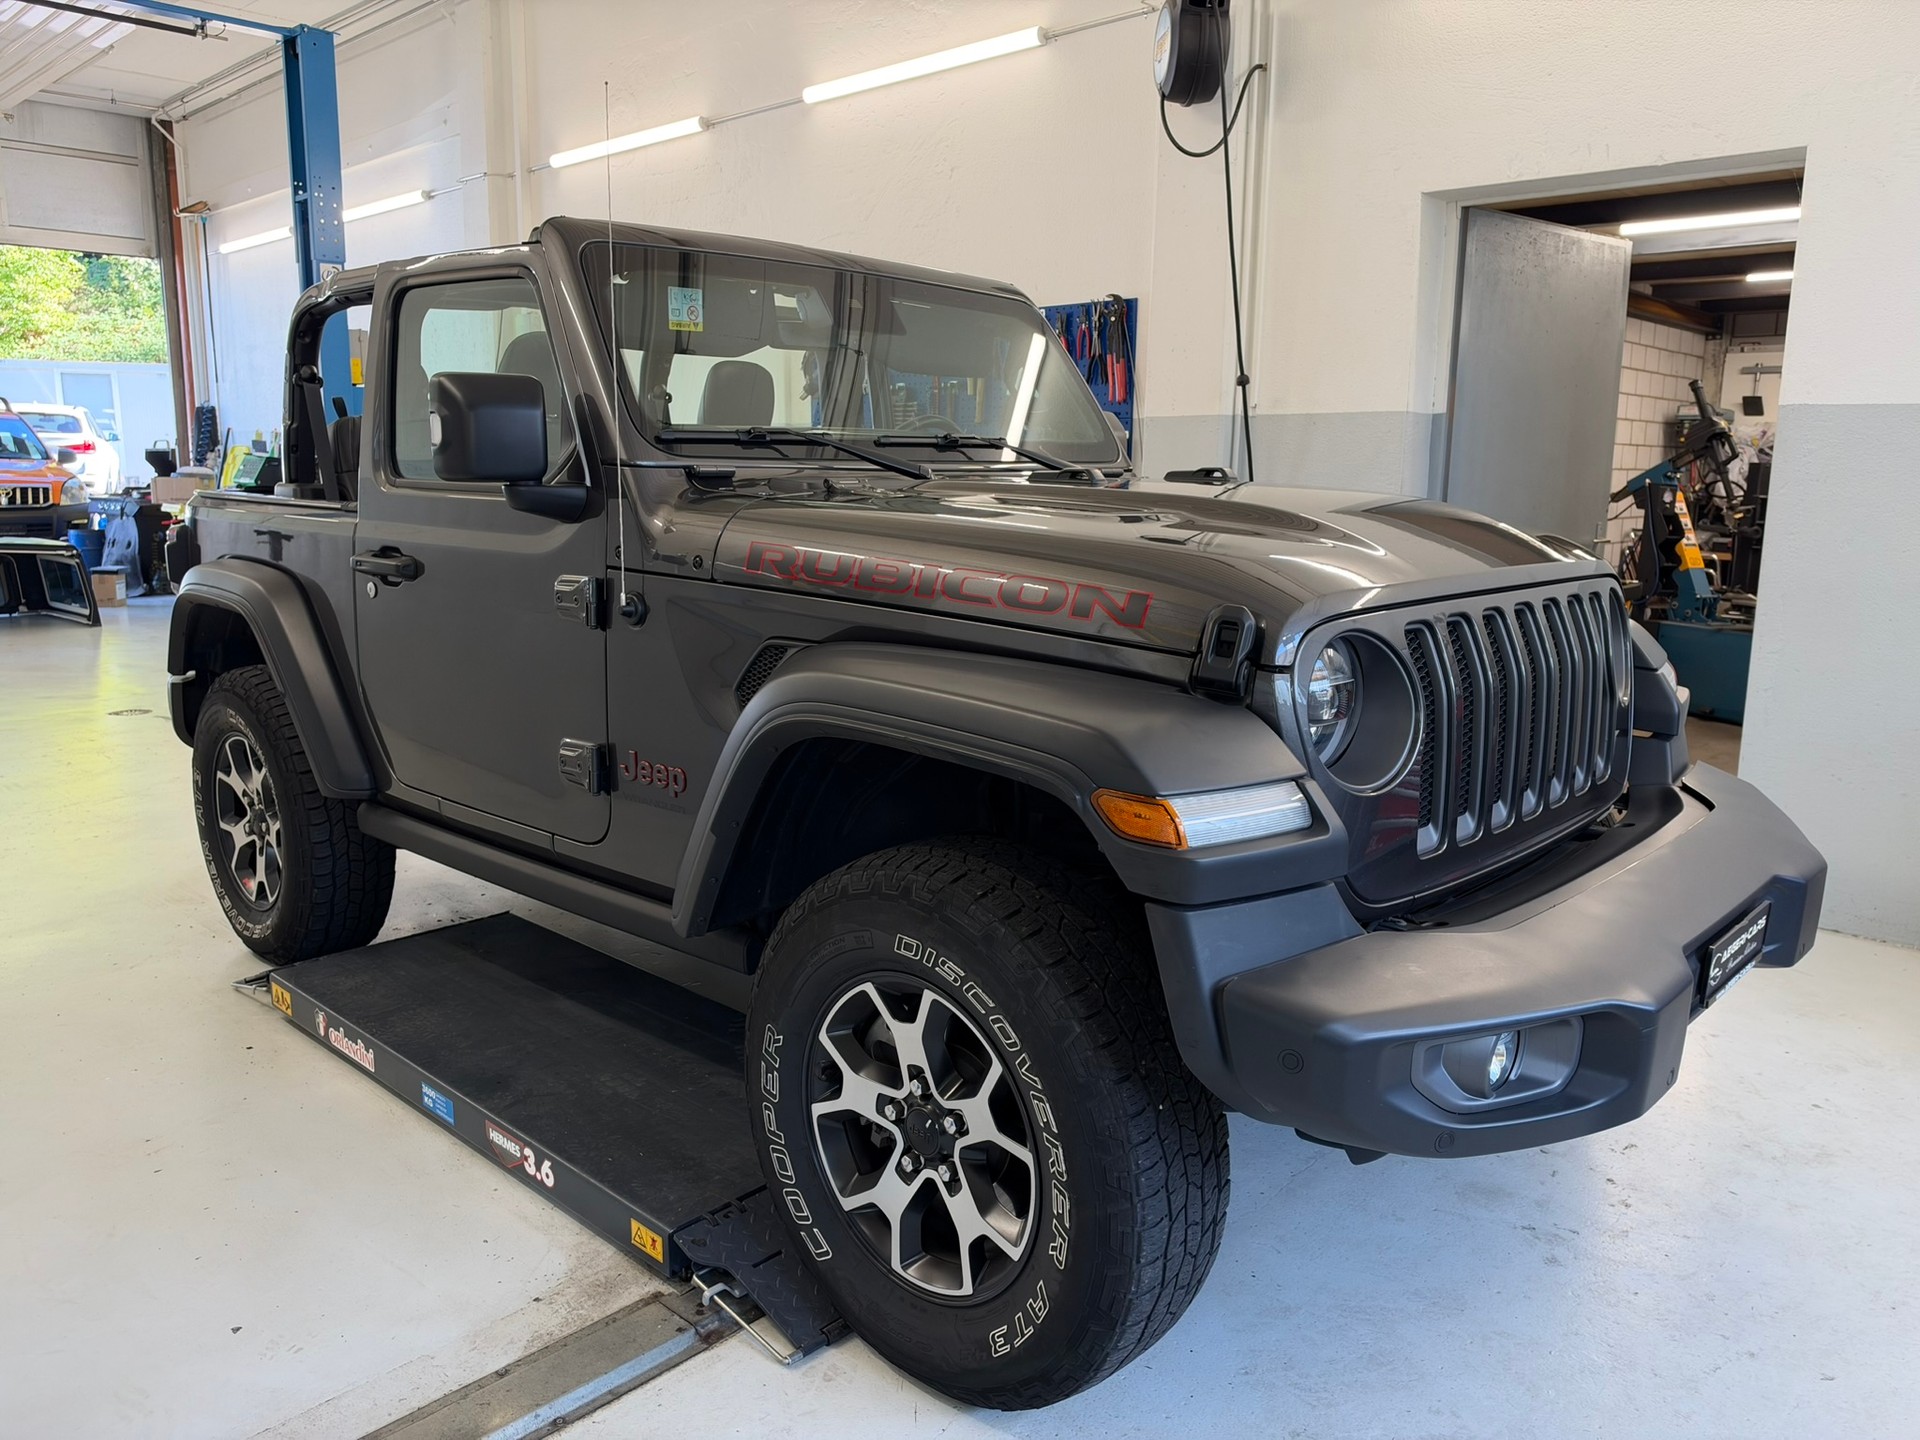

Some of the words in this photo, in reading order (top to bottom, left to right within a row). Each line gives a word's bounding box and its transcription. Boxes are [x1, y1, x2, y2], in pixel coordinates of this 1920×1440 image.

[744, 541, 1154, 629] RUBICON
[620, 750, 687, 798] Jeep
[489, 1127, 521, 1158] HERMES
[523, 1147, 555, 1188] 3.6
[762, 1023, 833, 1262] COOPER
[894, 933, 1071, 1270] DISCOVERER
[989, 1279, 1050, 1358] AT3
